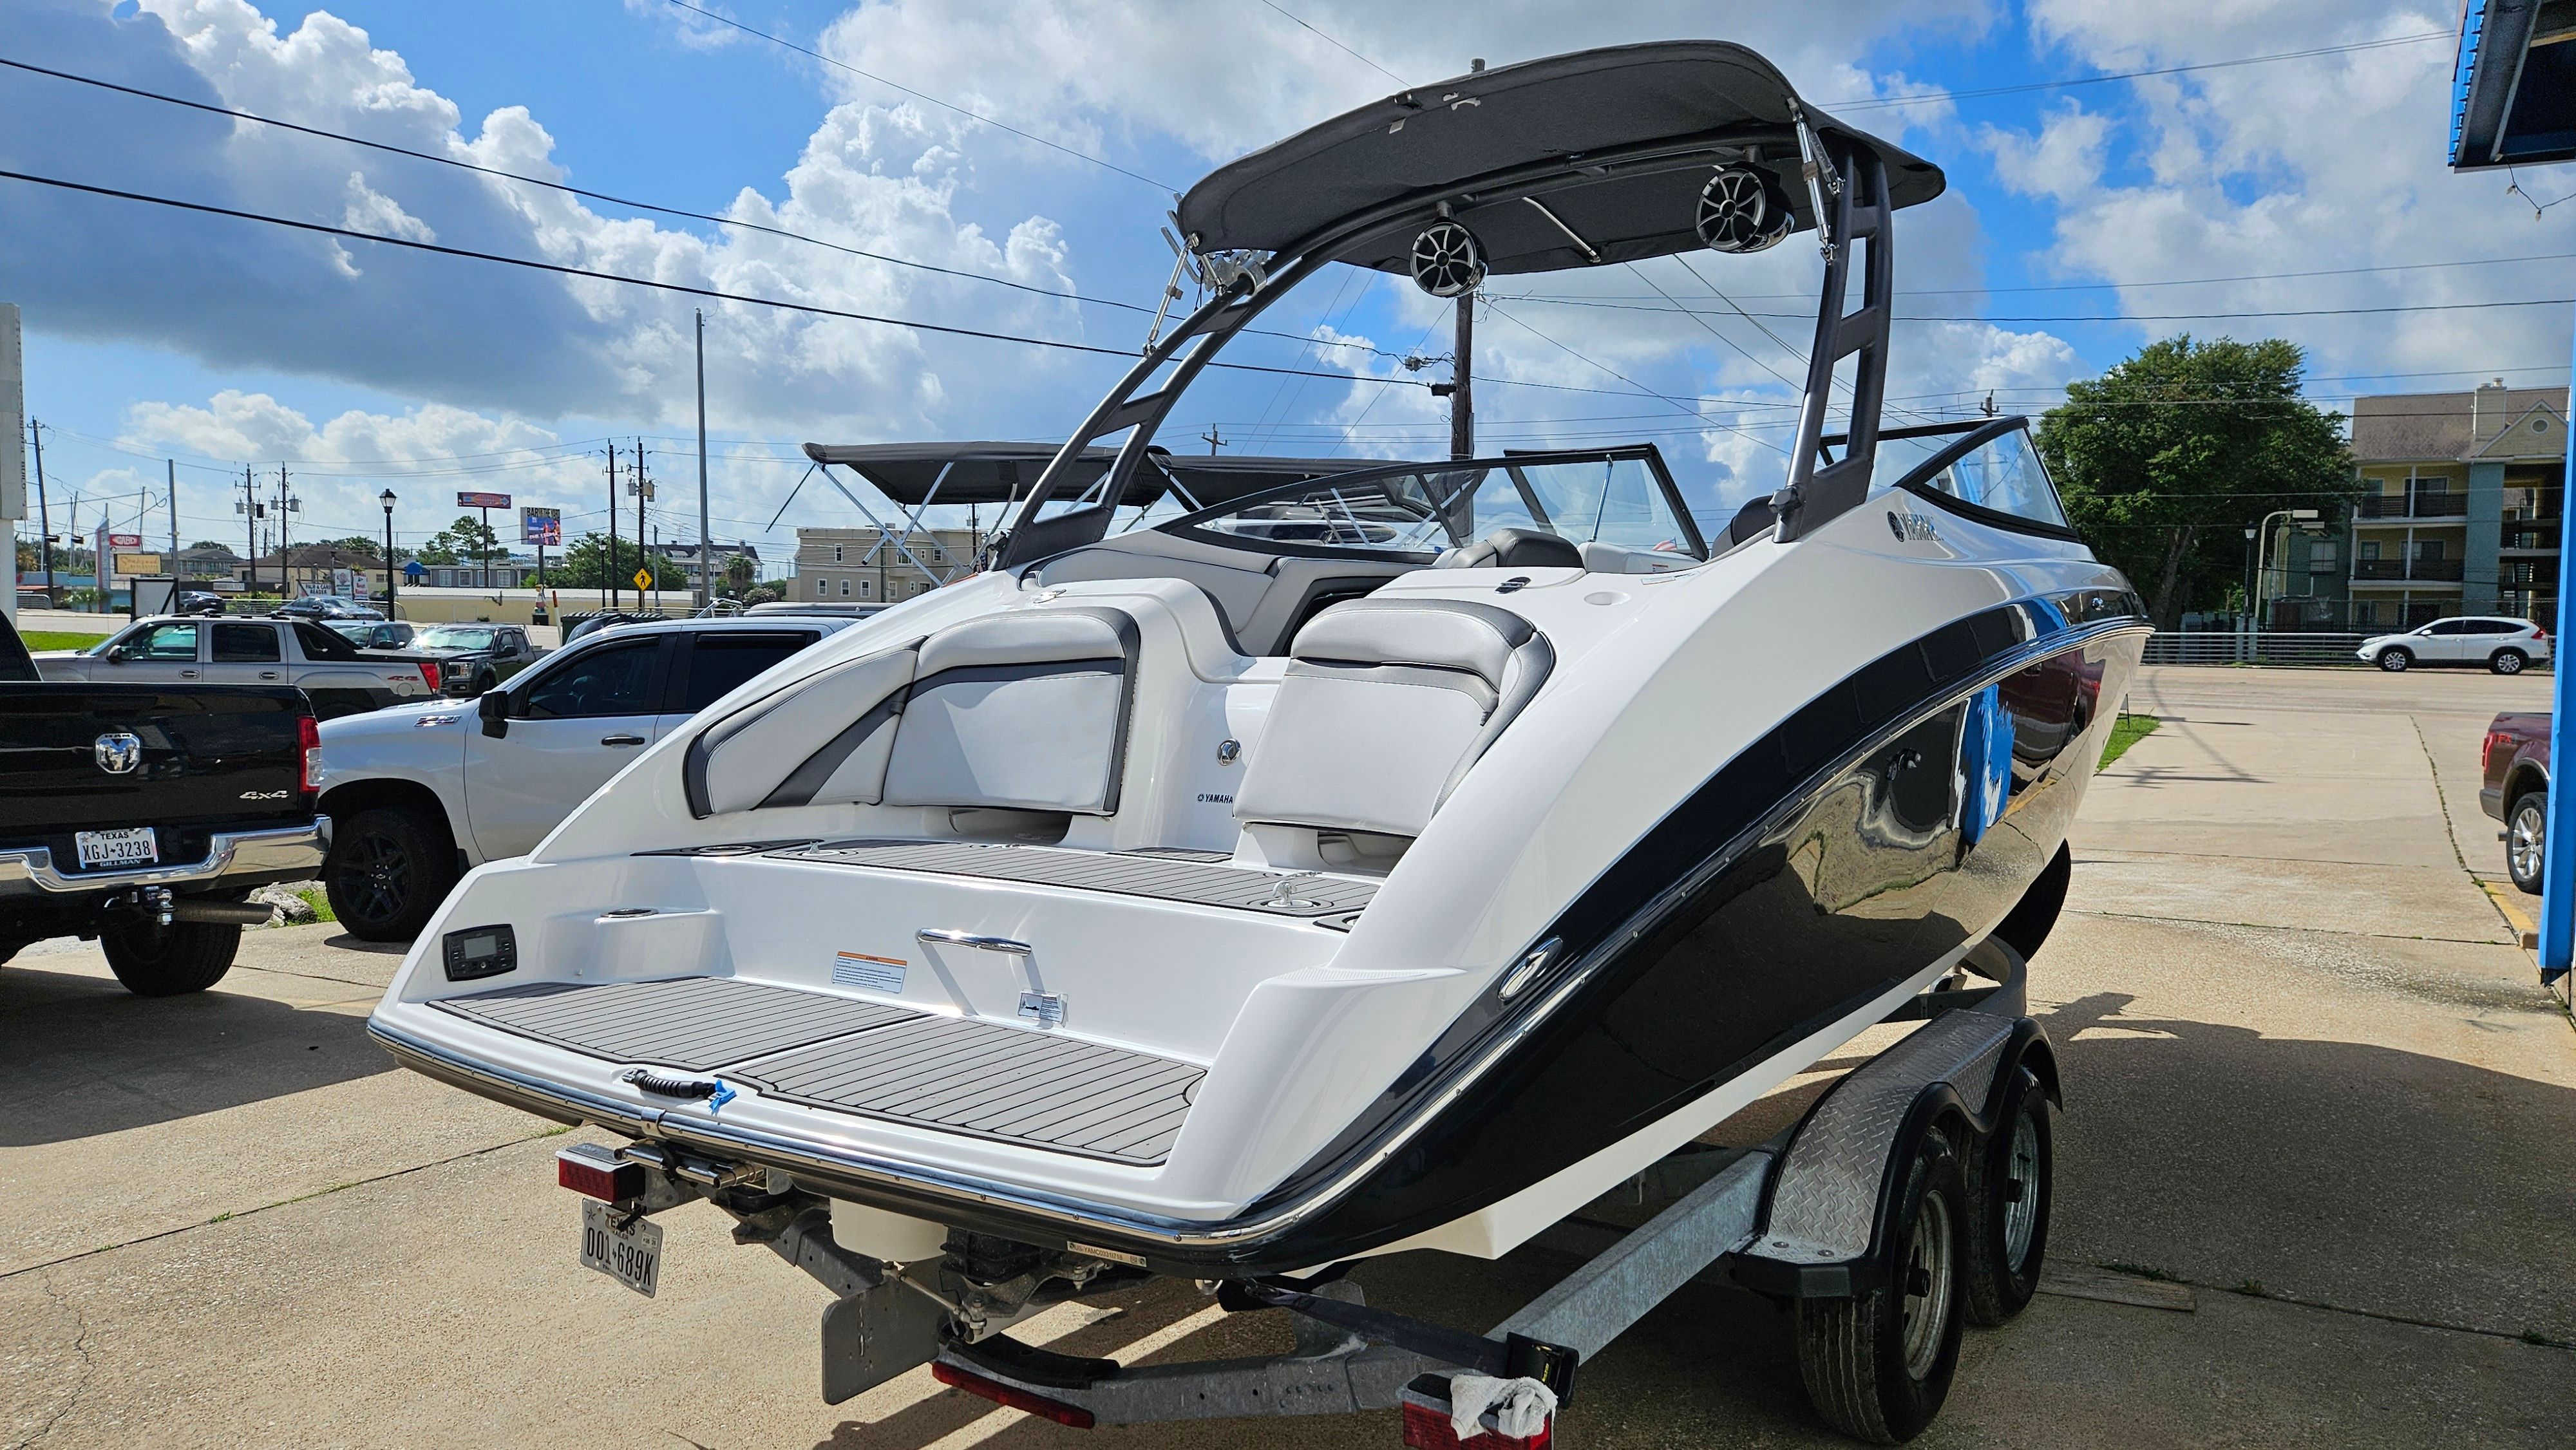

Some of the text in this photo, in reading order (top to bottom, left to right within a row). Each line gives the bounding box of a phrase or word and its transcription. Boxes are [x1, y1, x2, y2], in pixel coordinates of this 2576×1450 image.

[1205, 794, 1233, 804] YAMAHA
[100, 832, 129, 840] TEXAS
[99, 859, 141, 867] GILLMAN
[605, 1213, 636, 1236] TES
